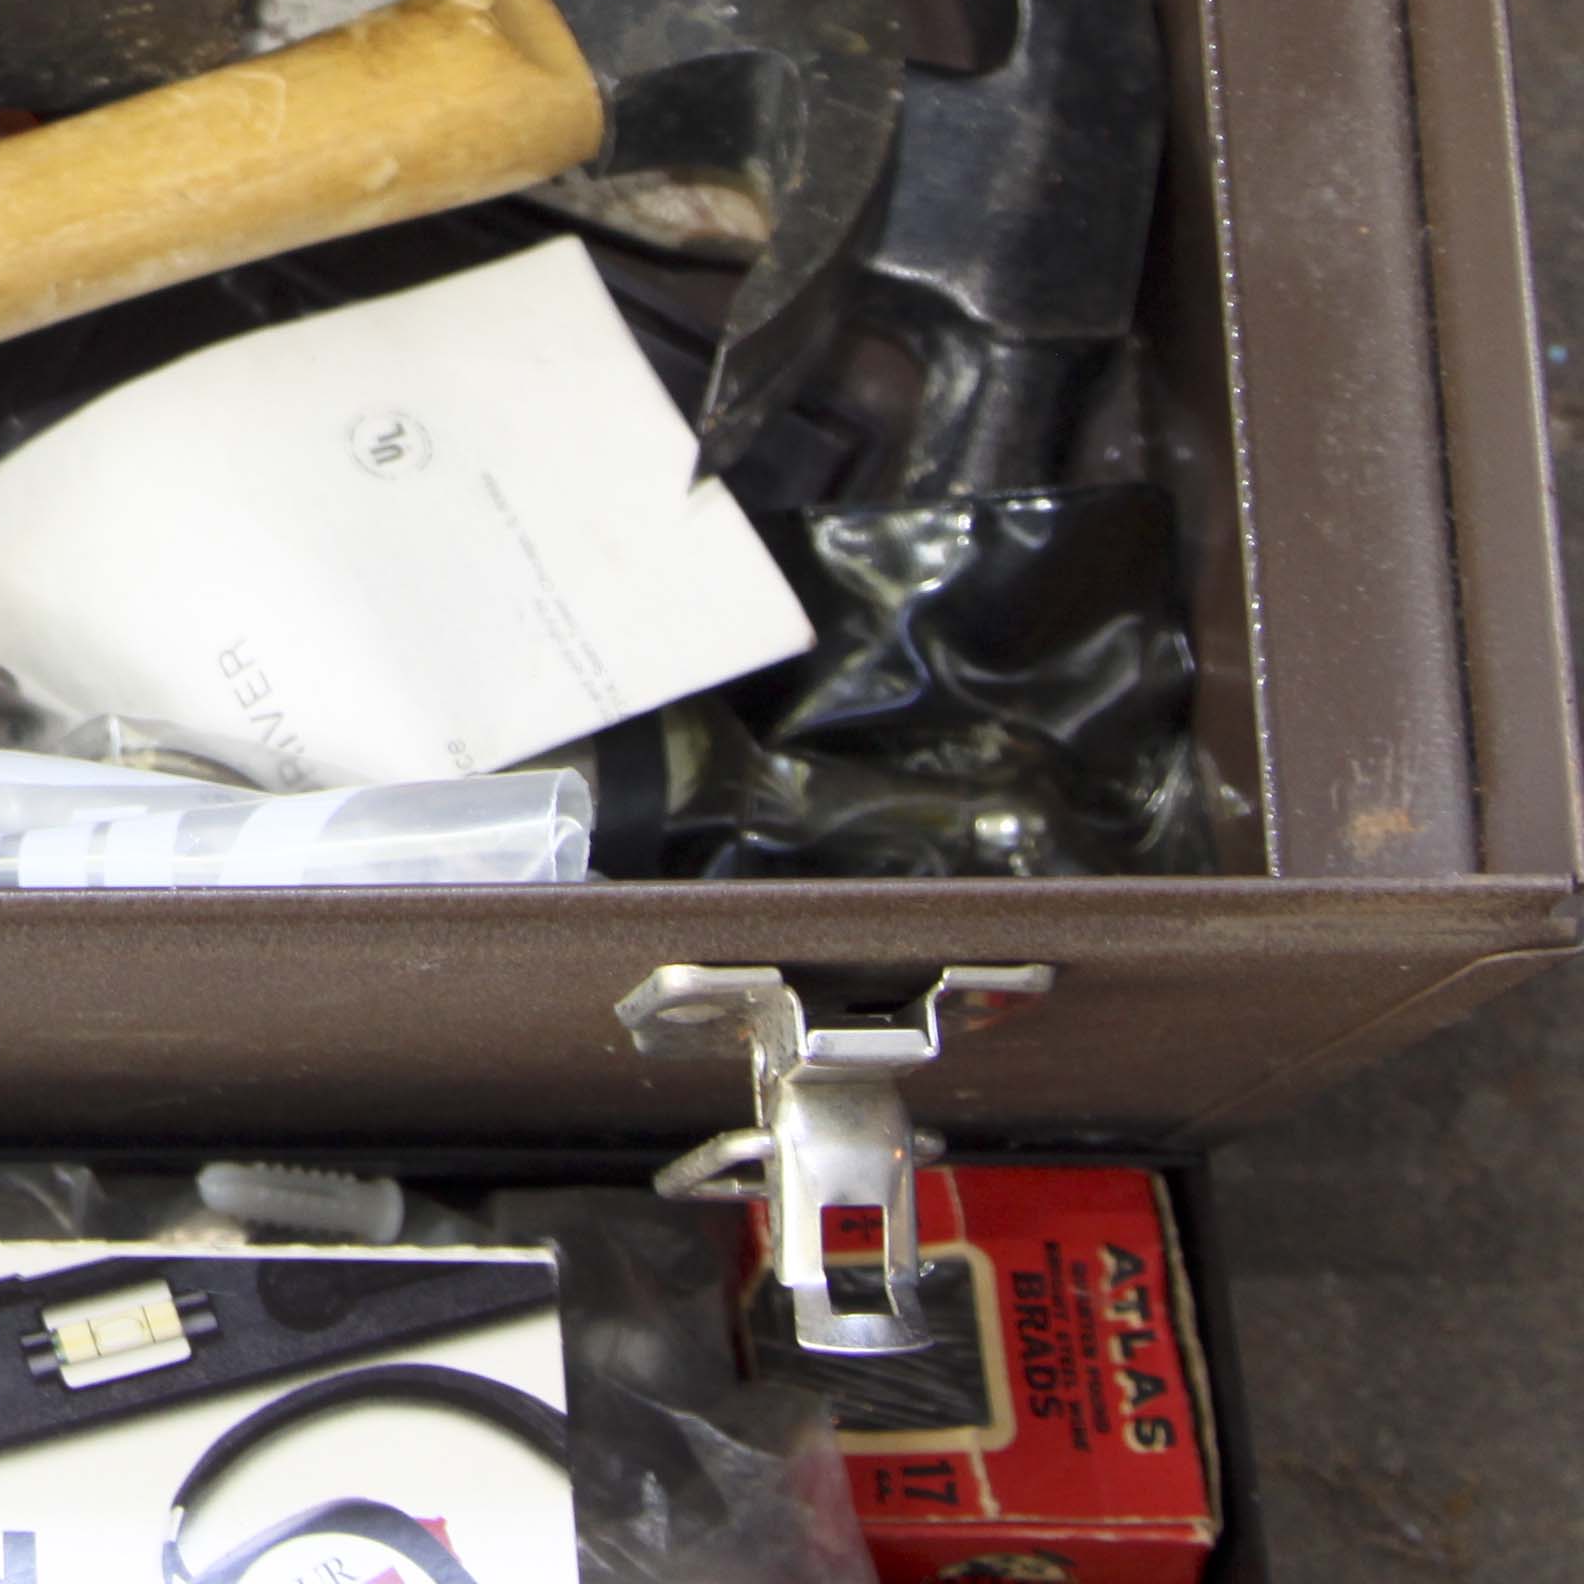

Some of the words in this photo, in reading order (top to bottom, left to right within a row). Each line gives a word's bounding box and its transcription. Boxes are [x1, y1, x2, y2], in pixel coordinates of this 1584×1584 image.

[1012, 1271, 1064, 1419] BRADS
[1100, 1242, 1177, 1453] ATLAS
[902, 1459, 959, 1505] 17
